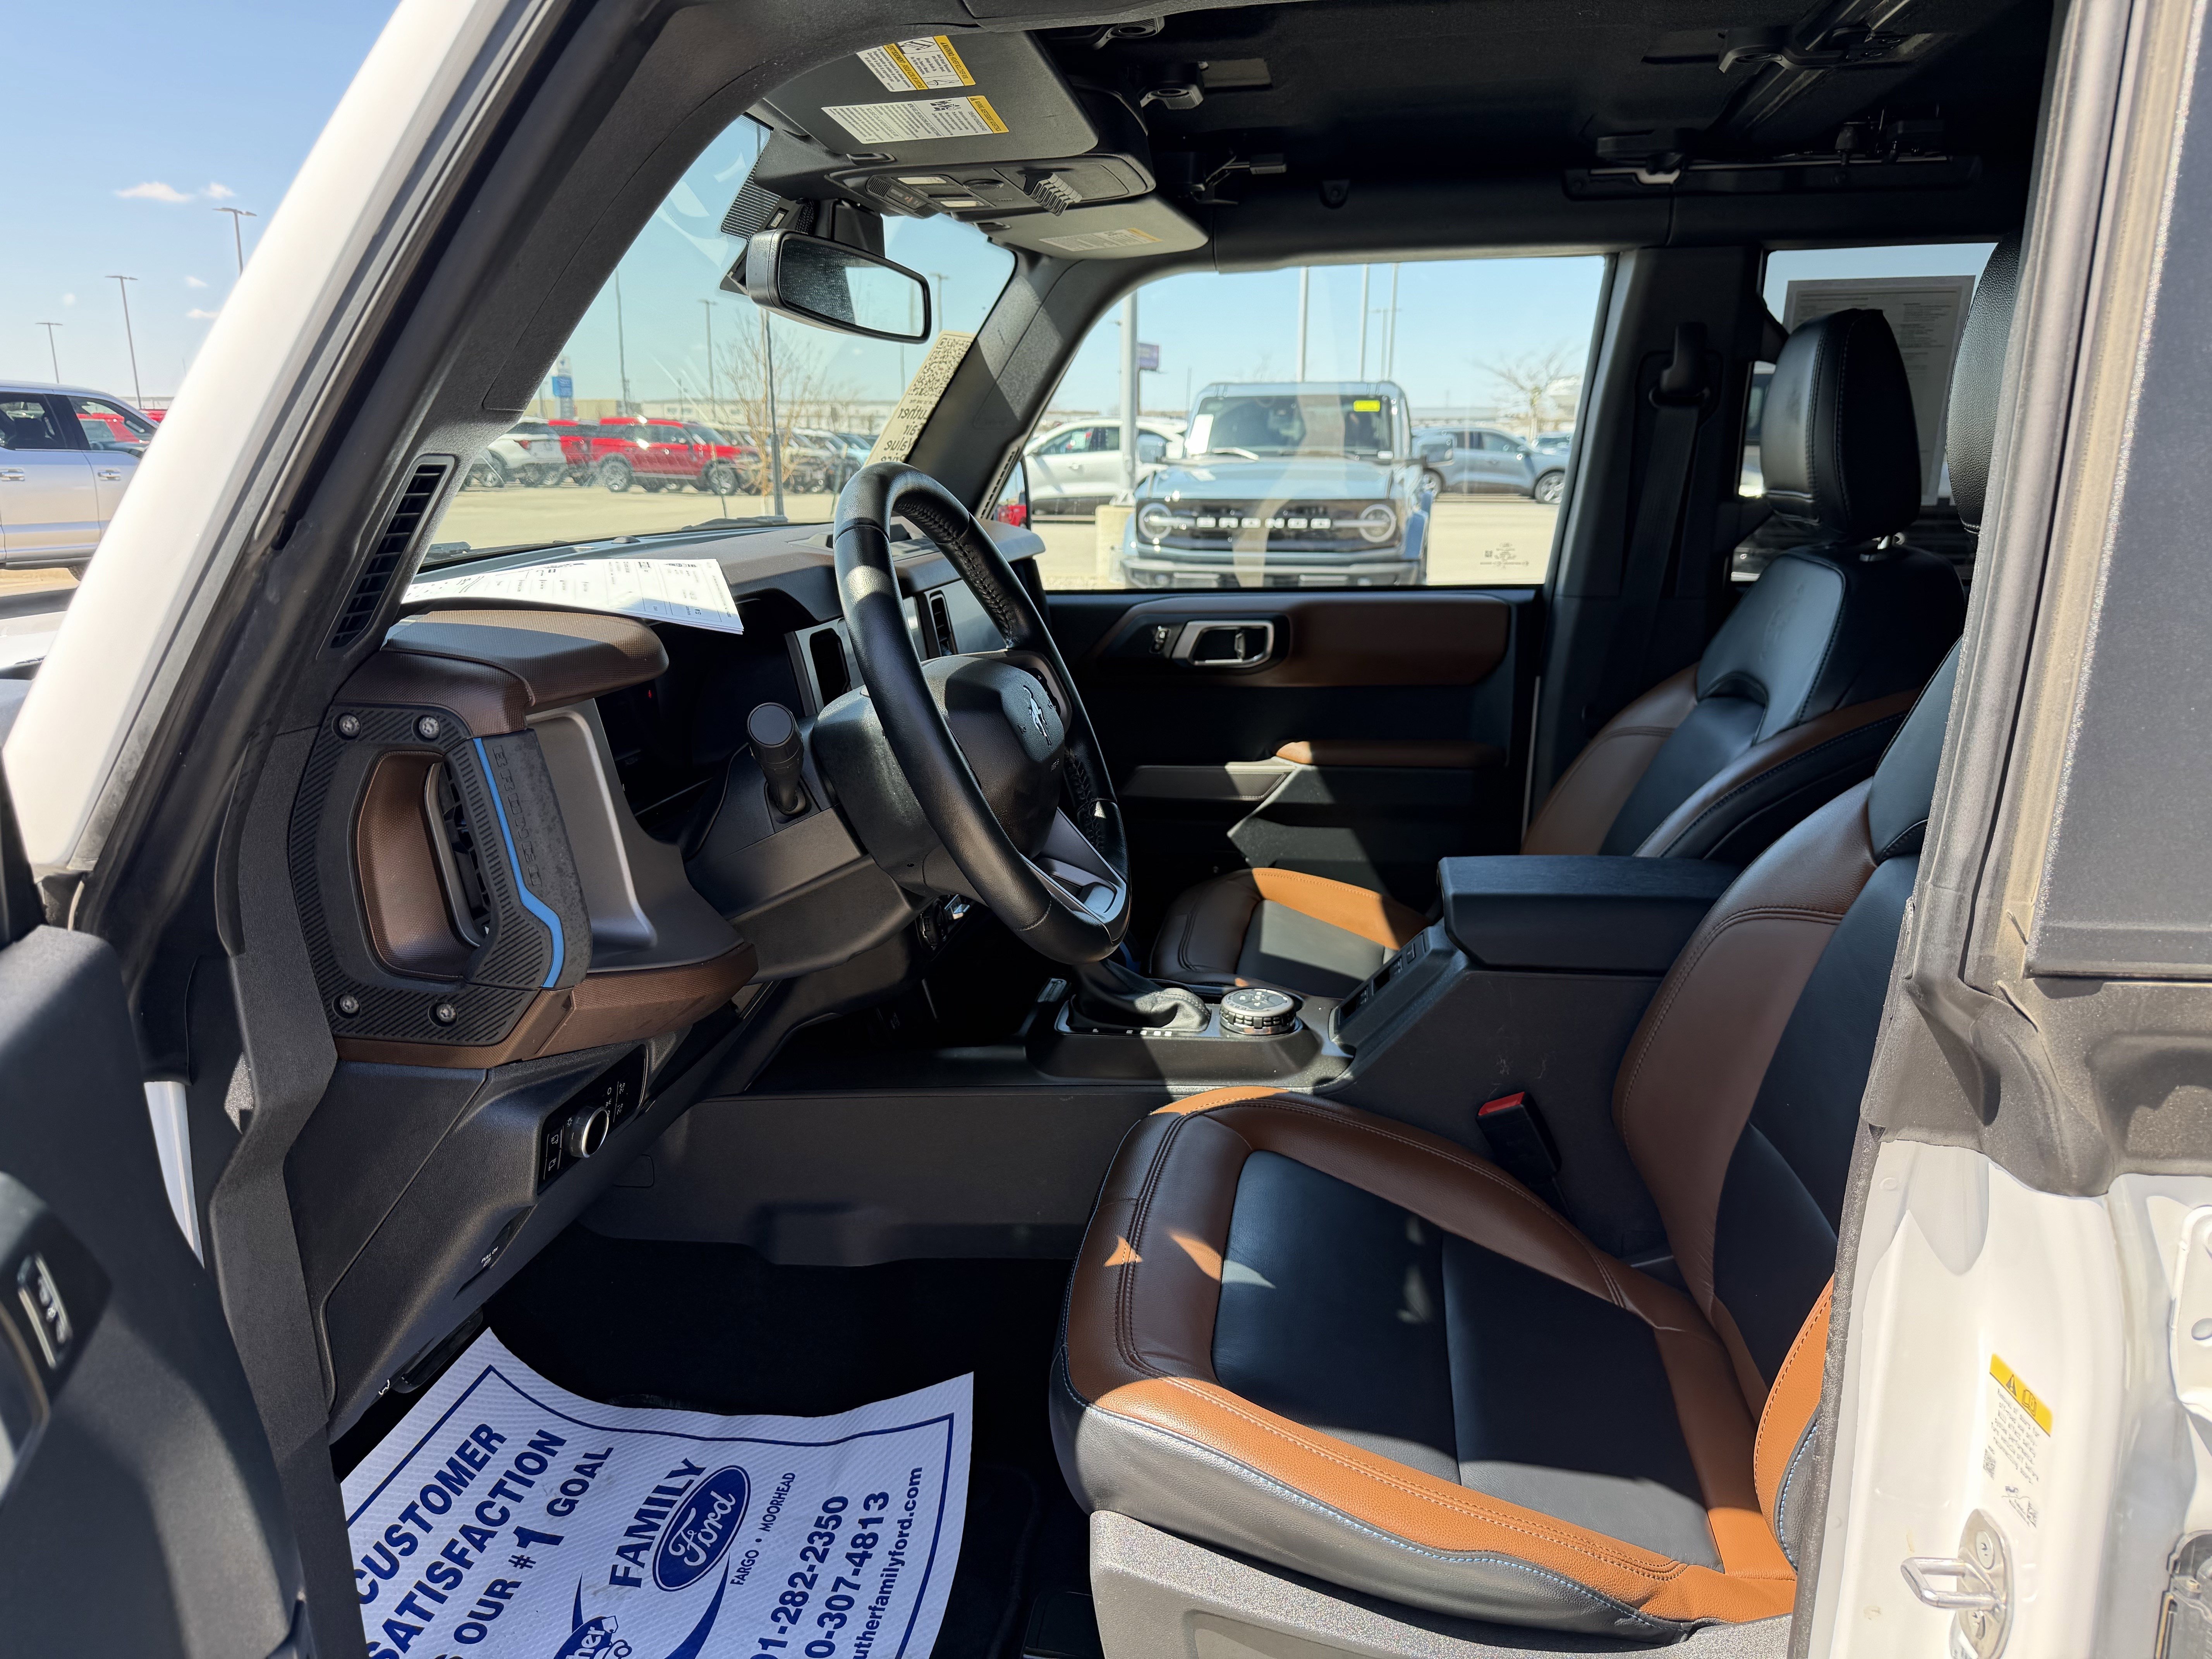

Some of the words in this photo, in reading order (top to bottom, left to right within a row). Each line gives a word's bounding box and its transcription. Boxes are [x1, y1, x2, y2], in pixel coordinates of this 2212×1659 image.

[492, 745, 542, 886] BRONCO
[354, 1423, 507, 1604] CUSTOMER
[453, 1578, 523, 1644] OUR
[508, 1525, 565, 1570] #1
[546, 1447, 614, 1517] GOAL
[608, 1458, 707, 1588] FAMILY
[668, 1491, 736, 1566] Ford
[730, 1549, 759, 1585] FARGO
[758, 1472, 795, 1532] MOORHEAD
